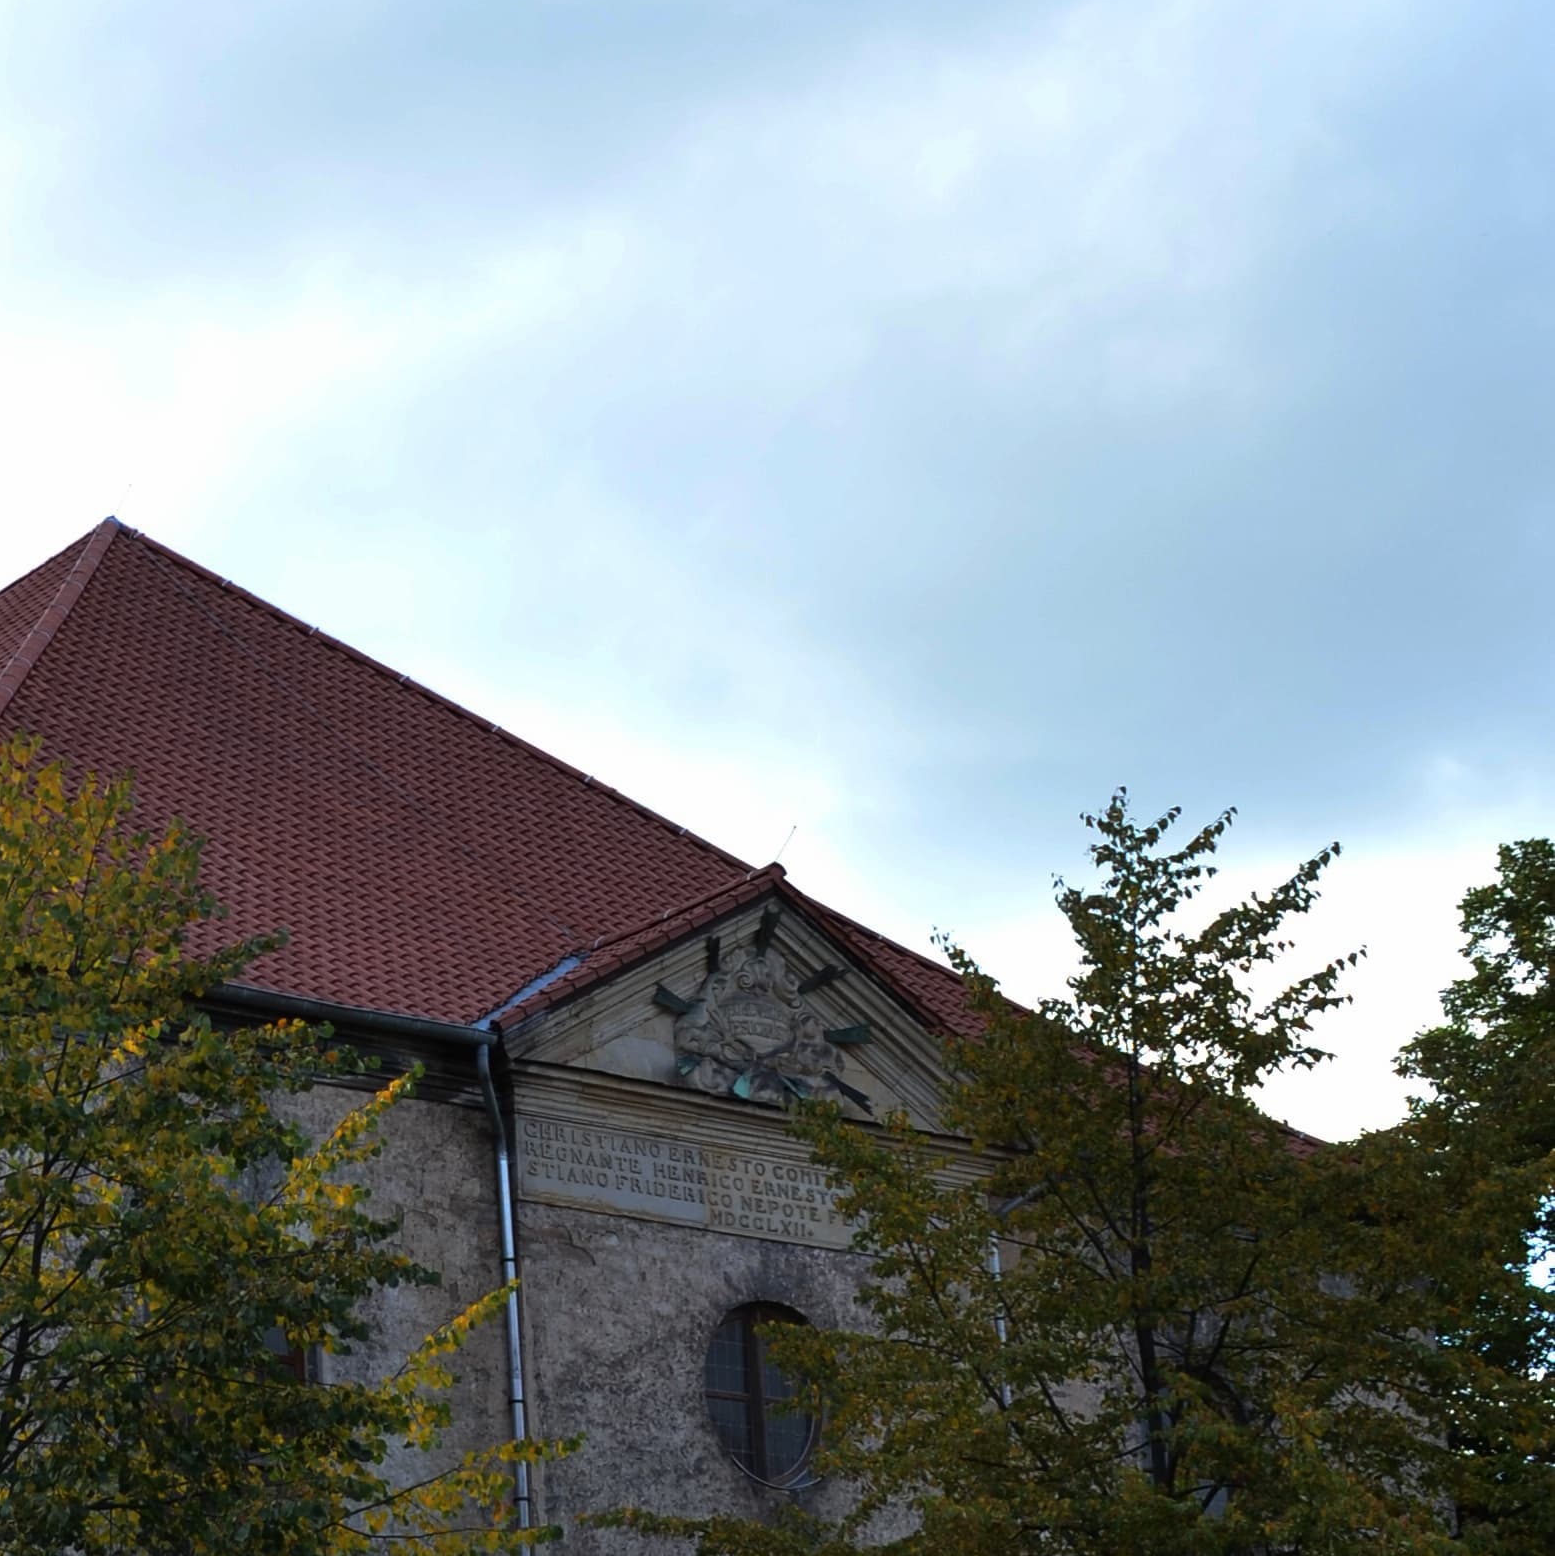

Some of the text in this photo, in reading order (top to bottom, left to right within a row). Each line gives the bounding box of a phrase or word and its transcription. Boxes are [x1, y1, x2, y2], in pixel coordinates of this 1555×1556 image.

[524, 1122, 661, 1158] CHRISTIANO
[668, 1146, 766, 1178] ERNESTO
[524, 1141, 642, 1174] REGNANTE
[653, 1161, 745, 1192] HENRICO
[526, 1161, 609, 1189] STIANO
[615, 1174, 733, 1208] FRIDERICO
[740, 1196, 821, 1224] NEPOTE
